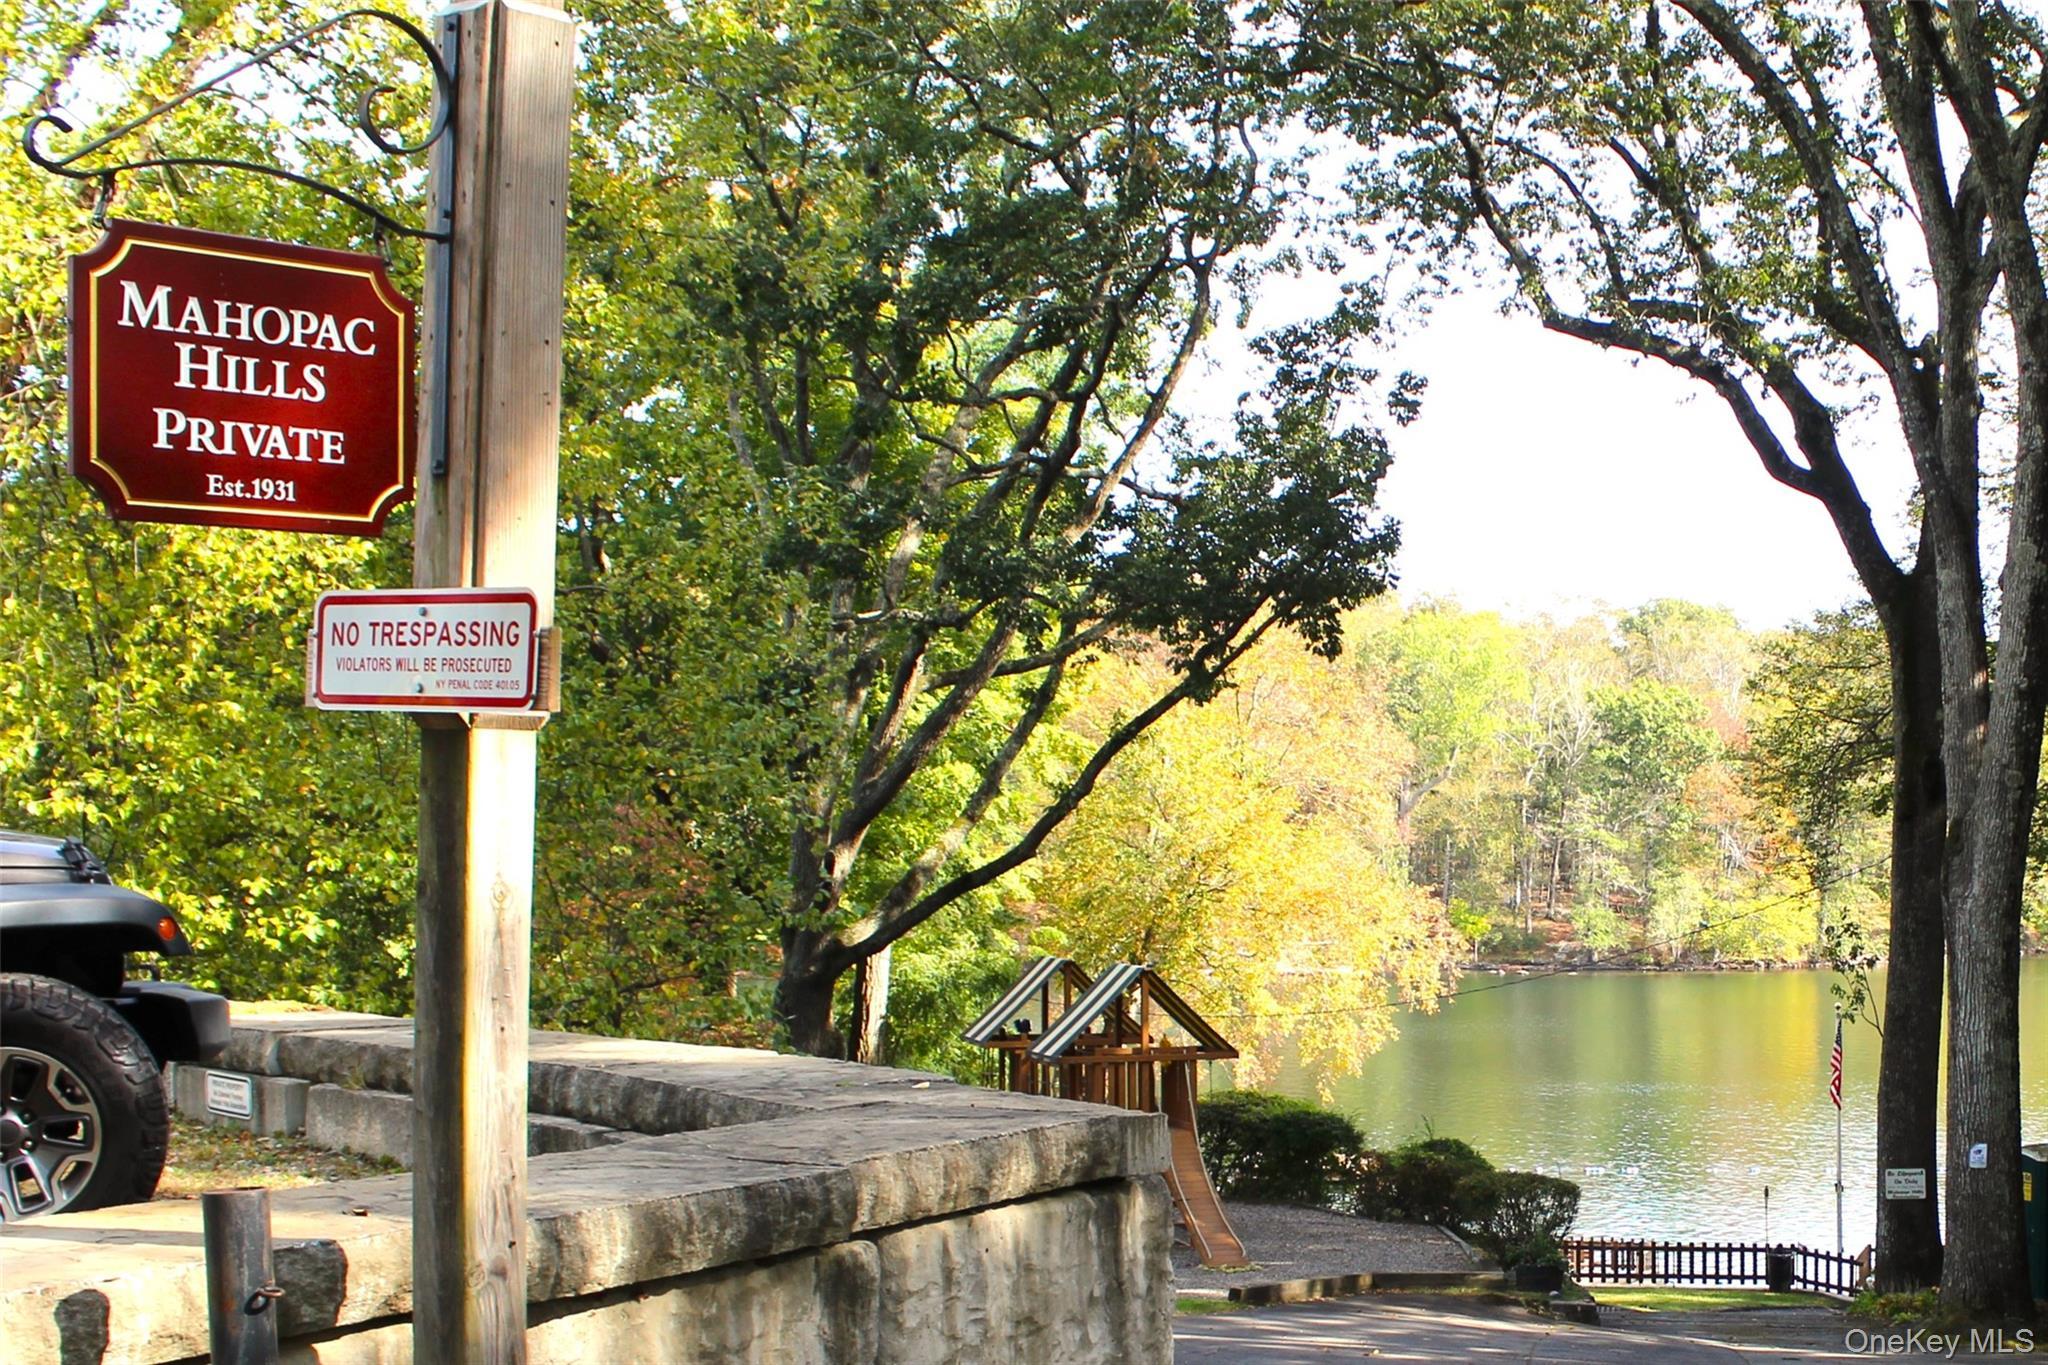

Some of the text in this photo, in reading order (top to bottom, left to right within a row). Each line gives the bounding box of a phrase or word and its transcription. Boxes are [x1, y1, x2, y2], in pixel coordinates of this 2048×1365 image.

[117, 279, 376, 356] MAHOPAC
[174, 342, 326, 403] HILLS
[152, 407, 346, 465] PRIVATE
[331, 620, 520, 647] NO TRESPASSING
[336, 656, 512, 673] VIOLATORS WILL BE PROSECUTED
[436, 679, 446, 689] NY
[448, 679, 471, 690] PENAL
[473, 679, 494, 690] CODE
